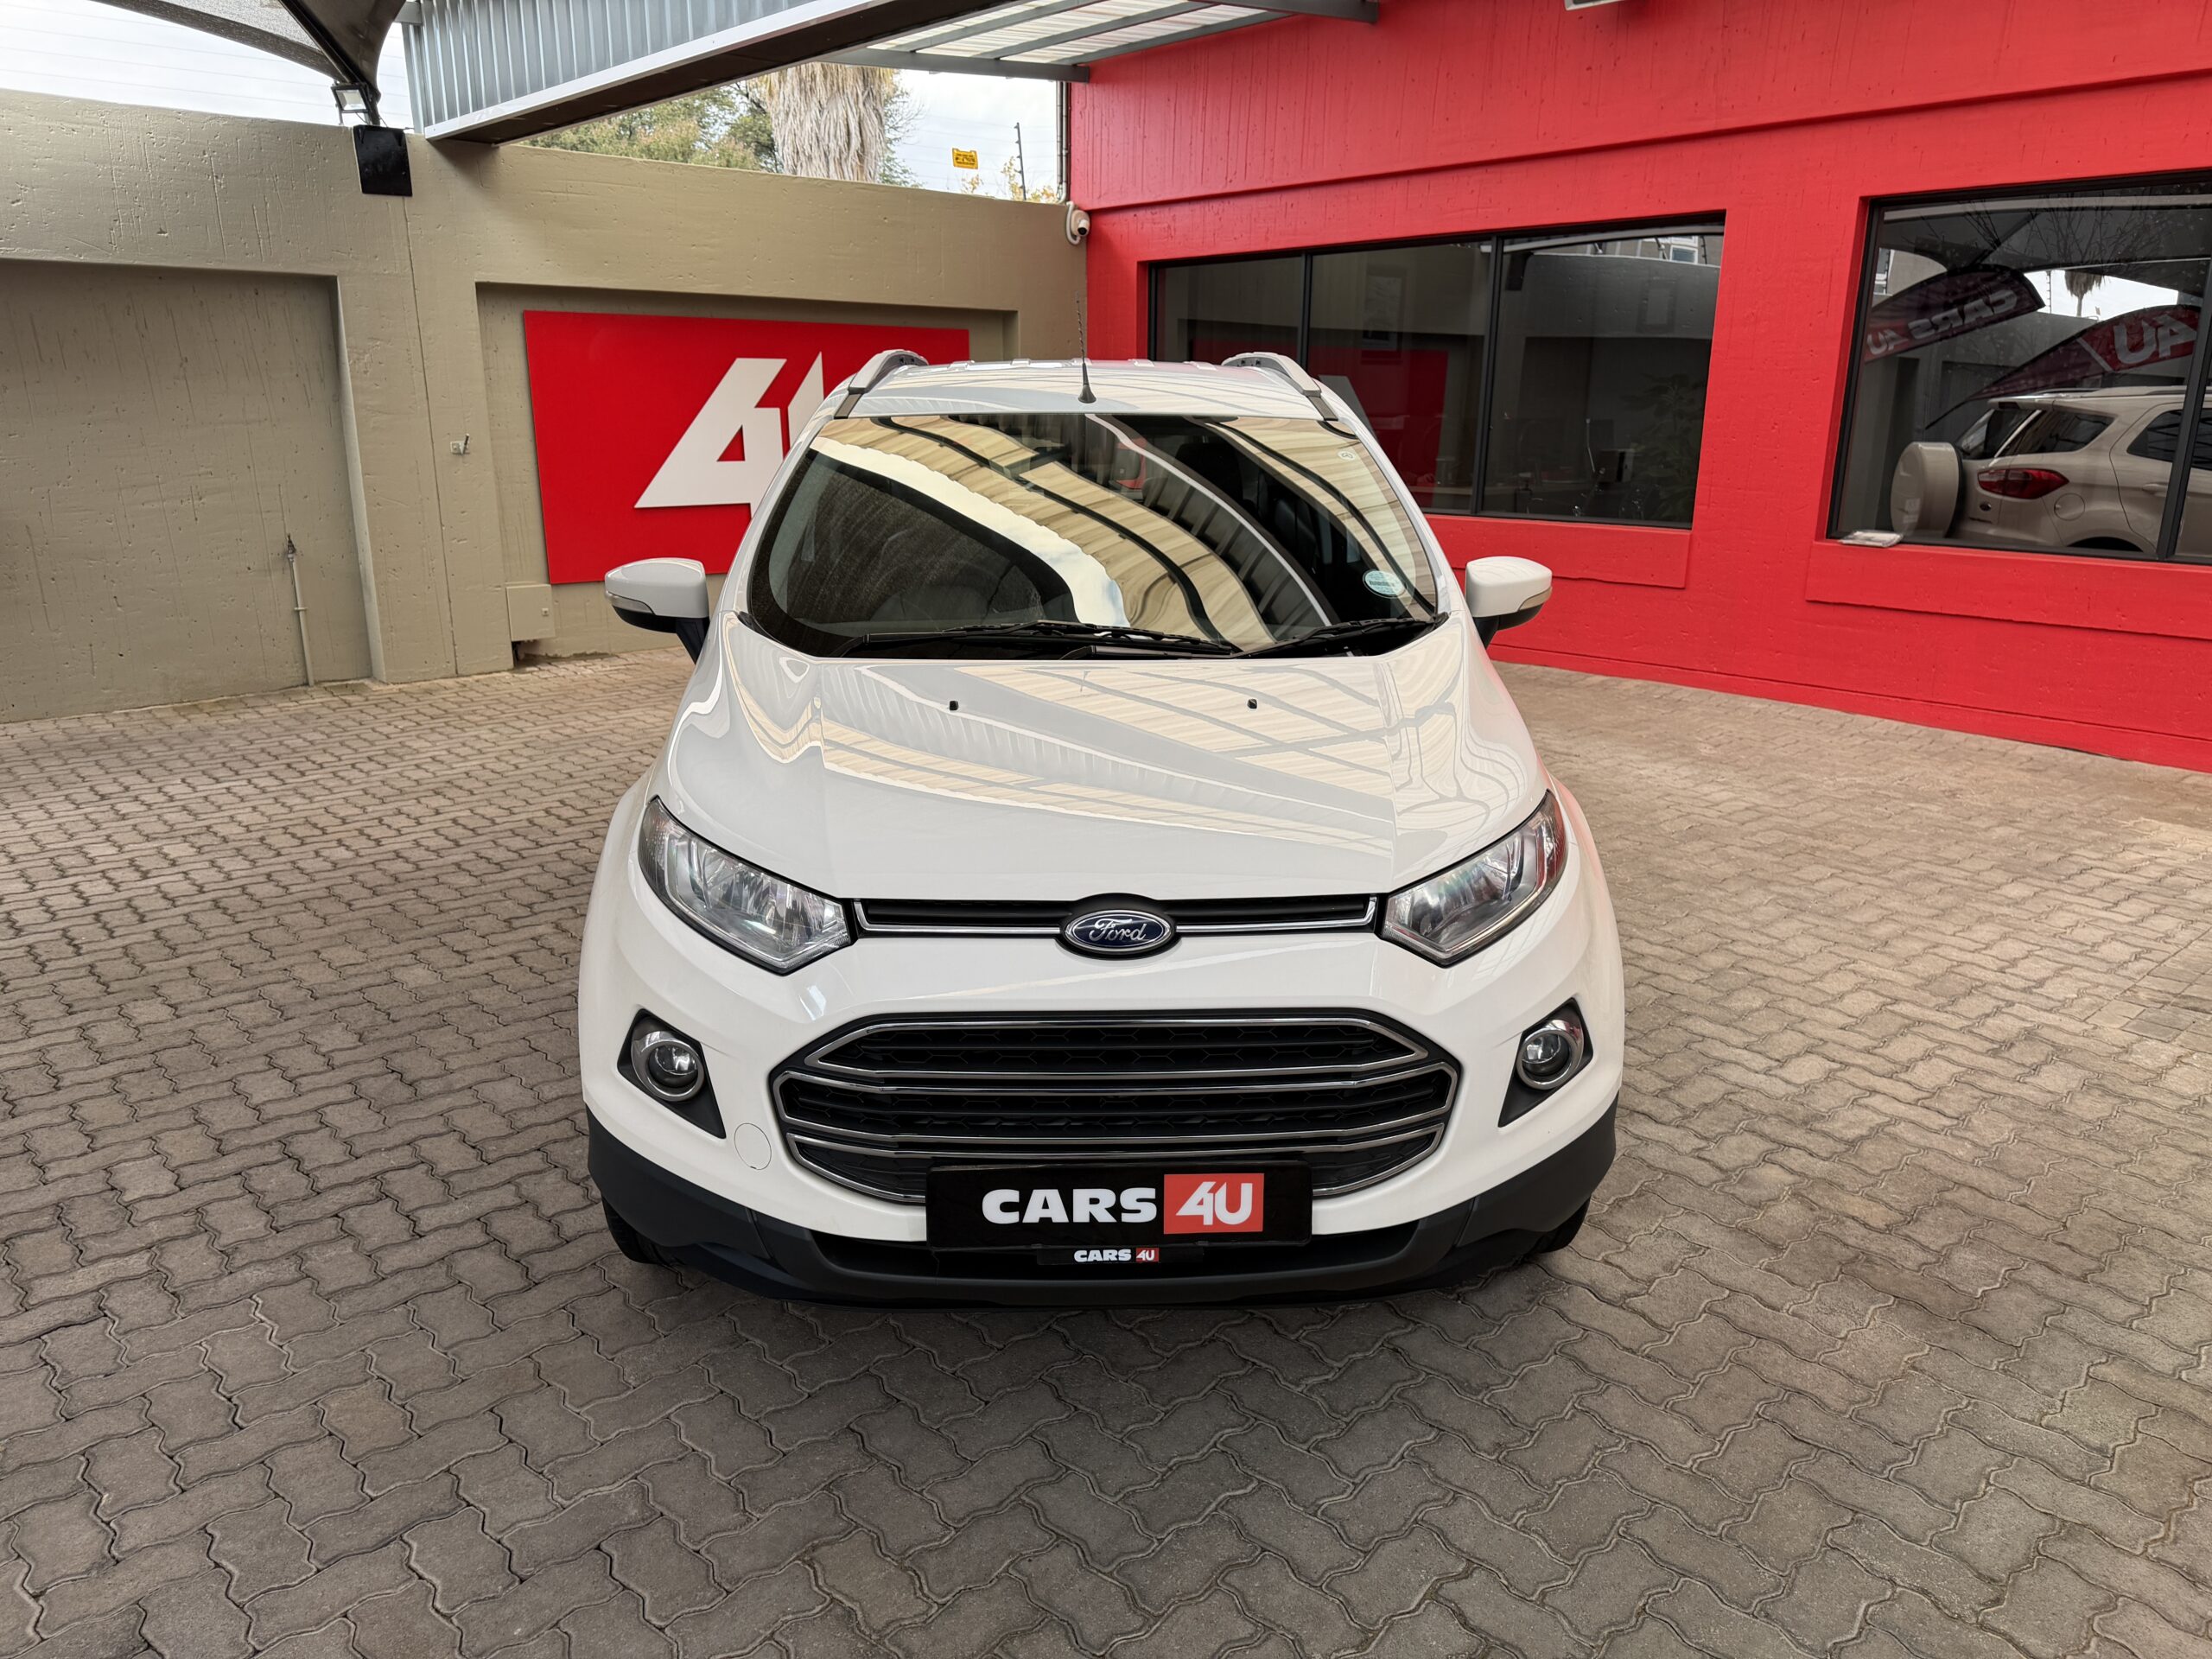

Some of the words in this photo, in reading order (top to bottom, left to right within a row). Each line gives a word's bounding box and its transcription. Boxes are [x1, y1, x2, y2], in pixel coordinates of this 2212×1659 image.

[633, 351, 824, 520] 4
[1089, 918, 1147, 941] Ford
[982, 1187, 1158, 1224] CARS
[1175, 1181, 1253, 1225] 4U
[1073, 1249, 1132, 1262] CARS
[1135, 1249, 1155, 1262] 4U
